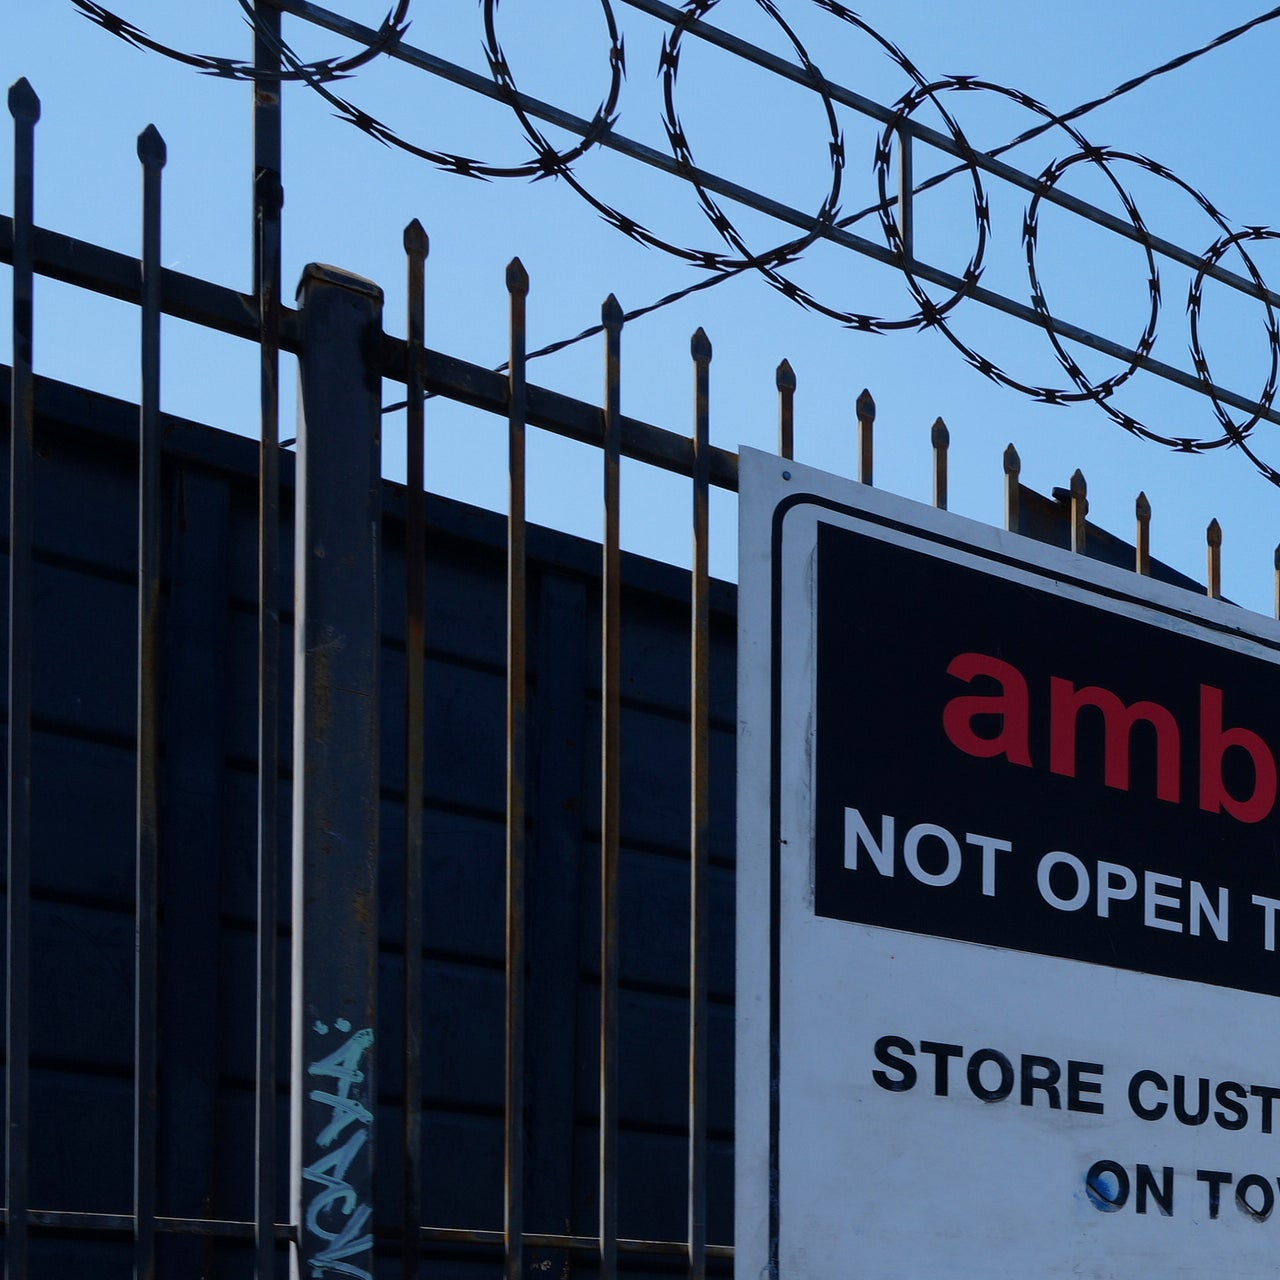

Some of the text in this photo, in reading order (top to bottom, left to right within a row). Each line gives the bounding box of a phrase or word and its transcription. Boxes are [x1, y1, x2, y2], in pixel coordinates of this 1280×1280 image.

[844, 807, 1012, 897] NOT
[1037, 851, 1229, 942] OPEN
[871, 1035, 1105, 1115] STORE
[1084, 1159, 1175, 1218] ON
